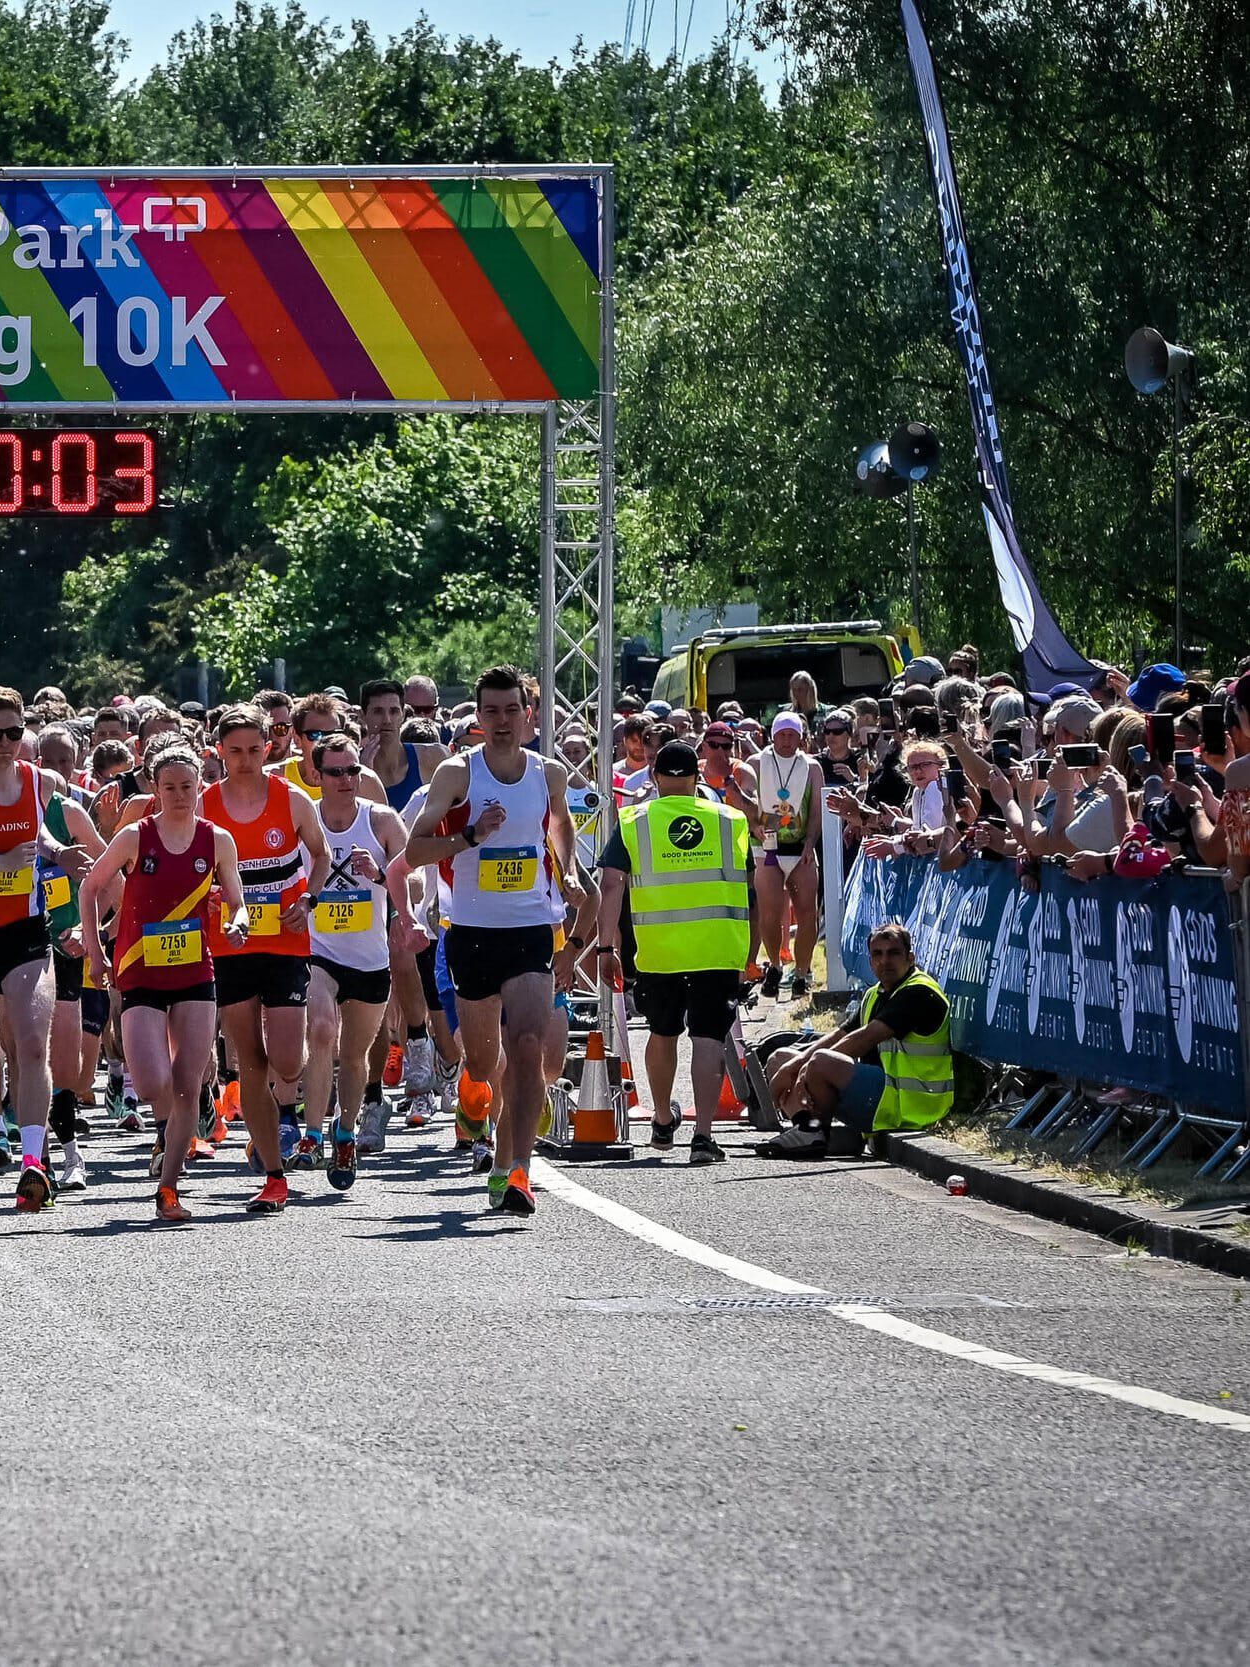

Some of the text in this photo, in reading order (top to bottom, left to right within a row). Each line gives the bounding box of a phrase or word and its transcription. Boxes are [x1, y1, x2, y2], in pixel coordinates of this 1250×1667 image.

[68, 295, 228, 367] 10K
[496, 861, 523, 876] 2436
[247, 905, 263, 920] 23
[328, 904, 354, 918] 2126
[160, 934, 187, 950] 2758
[1190, 971, 1239, 1033] RUNNING
